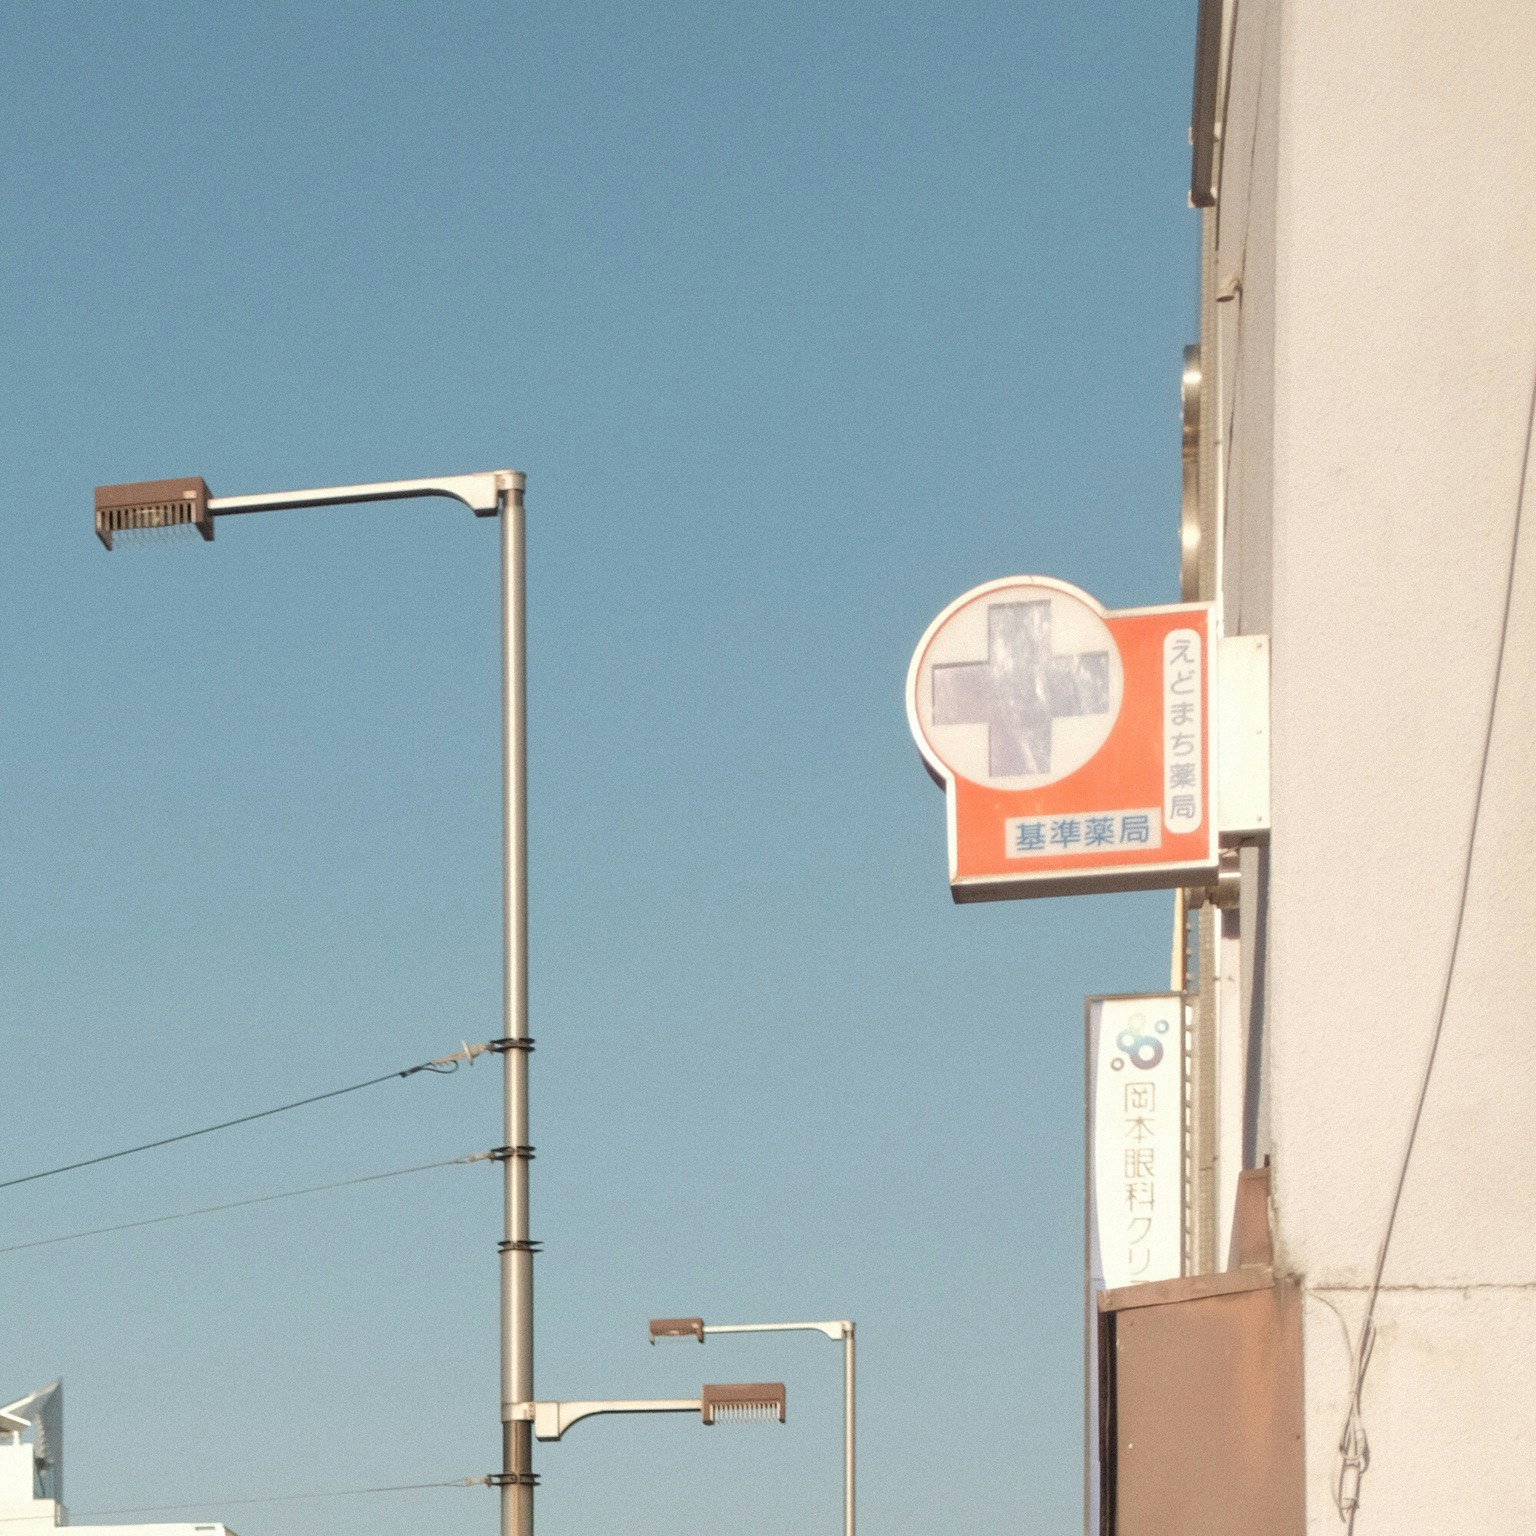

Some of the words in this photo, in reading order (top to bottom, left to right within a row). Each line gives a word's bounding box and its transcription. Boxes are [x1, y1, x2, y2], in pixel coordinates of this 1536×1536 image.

[1170, 639, 1196, 820] えどまち薬局
[1016, 814, 1149, 851] 基準薬局
